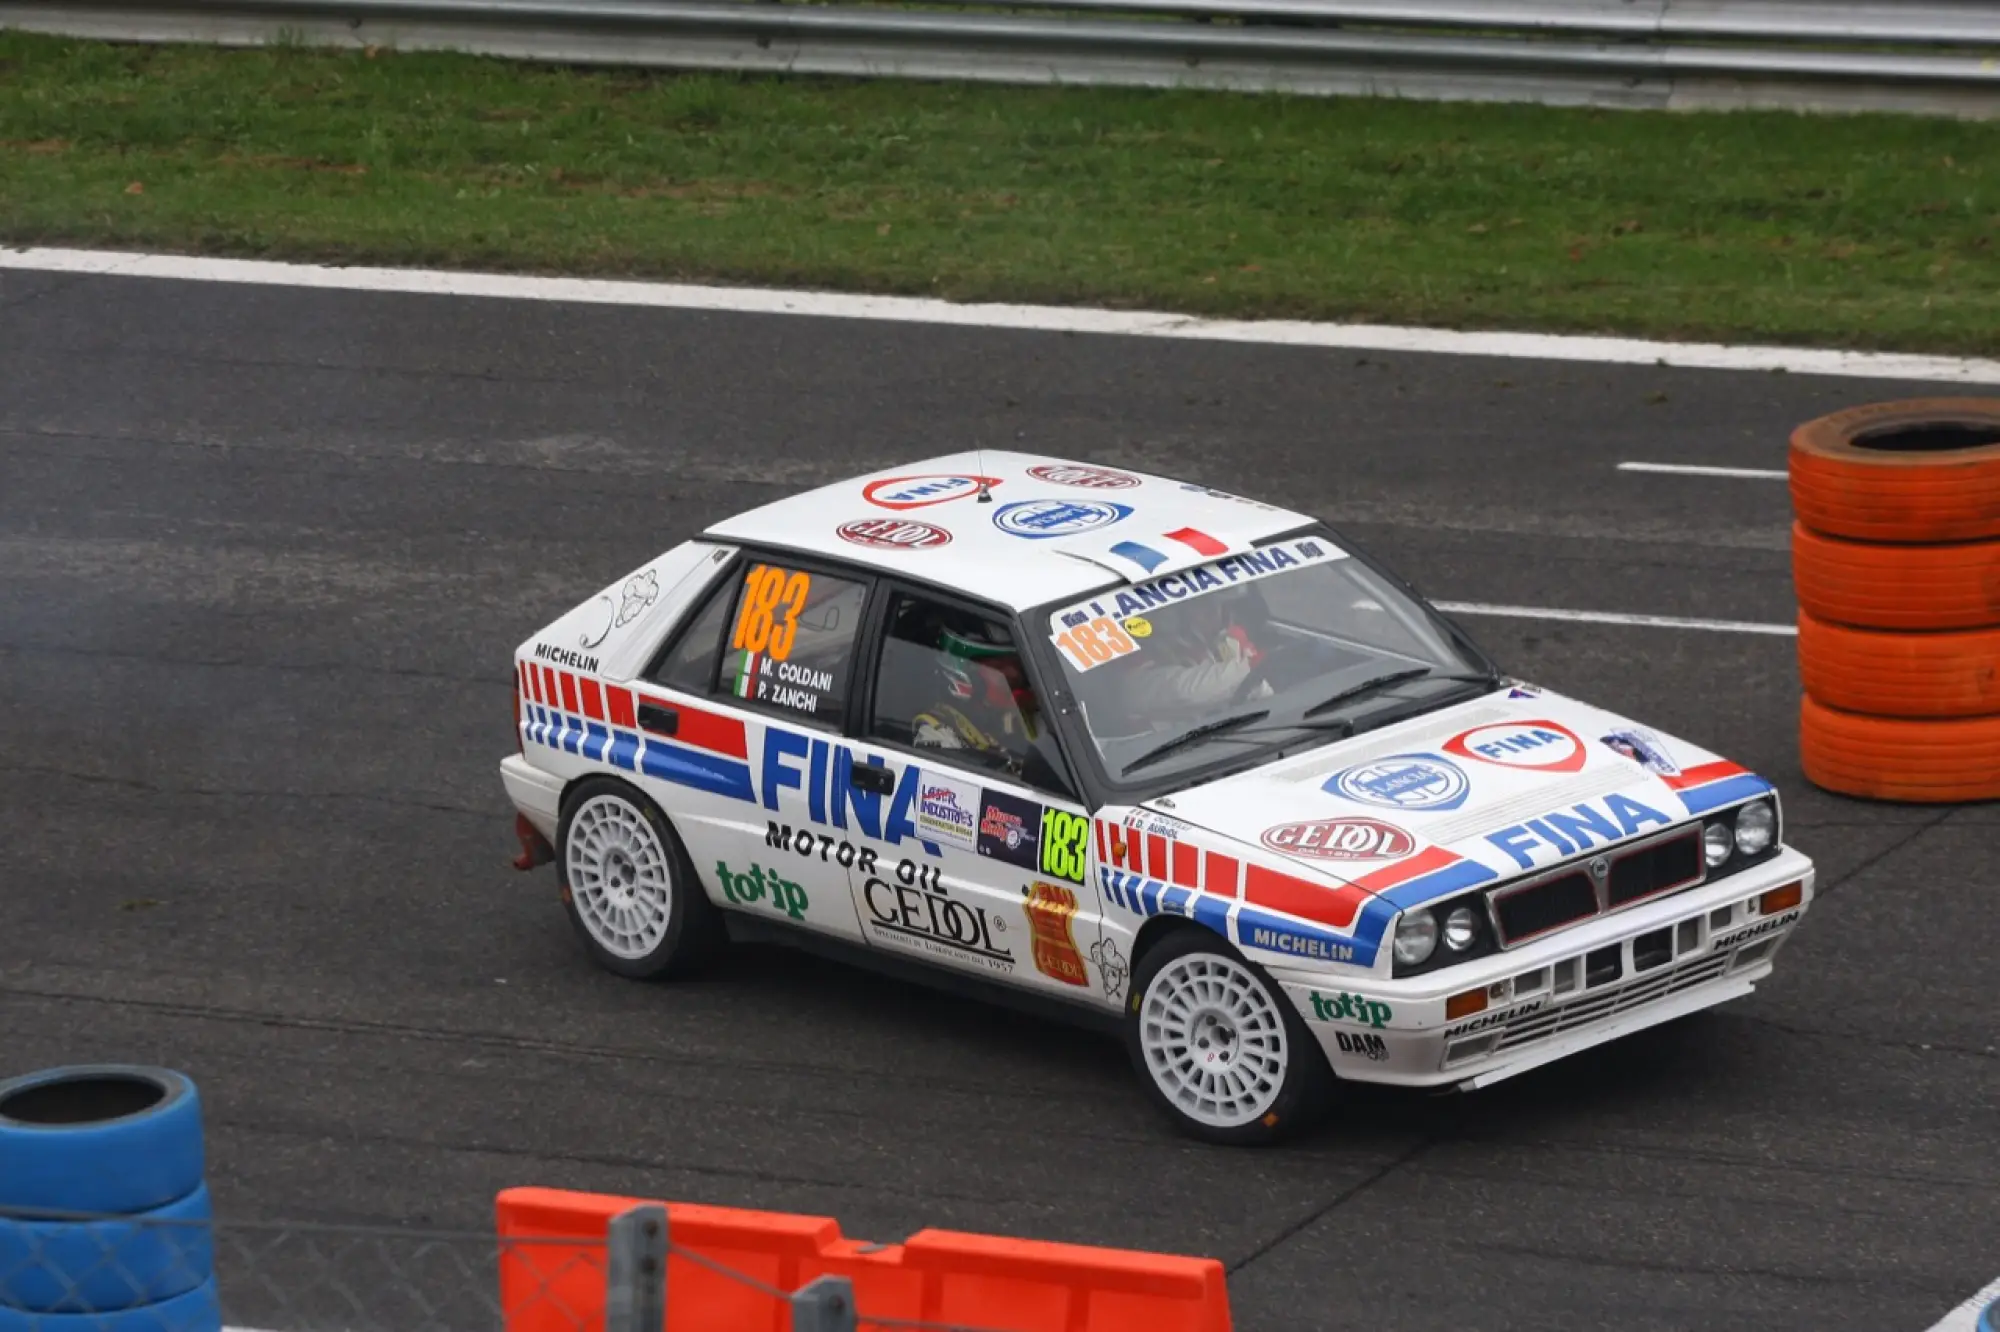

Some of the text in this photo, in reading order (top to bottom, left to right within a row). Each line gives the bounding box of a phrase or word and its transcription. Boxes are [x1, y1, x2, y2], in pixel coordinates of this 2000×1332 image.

[884, 478, 972, 501] FINA
[1215, 546, 1299, 582] FINA
[732, 563, 812, 662] 183
[534, 641, 599, 674] MICHELIN
[1056, 616, 1135, 669] 183
[760, 657, 834, 692] M. COLDANI
[757, 680, 818, 713] P. ZANCHI
[1473, 730, 1565, 758] FINA
[762, 725, 943, 858] FINA
[1042, 808, 1088, 884] 183
[1483, 792, 1672, 870] FINA
[765, 820, 879, 876] MOTOR
[895, 857, 948, 896] OIL
[715, 859, 809, 921] totip
[1253, 927, 1354, 961] MICHELIN
[1714, 911, 1799, 951] MICHELIN
[1309, 989, 1393, 1029] totip
[1443, 999, 1543, 1040] MICHELIN
[1334, 1030, 1387, 1055] DAM
